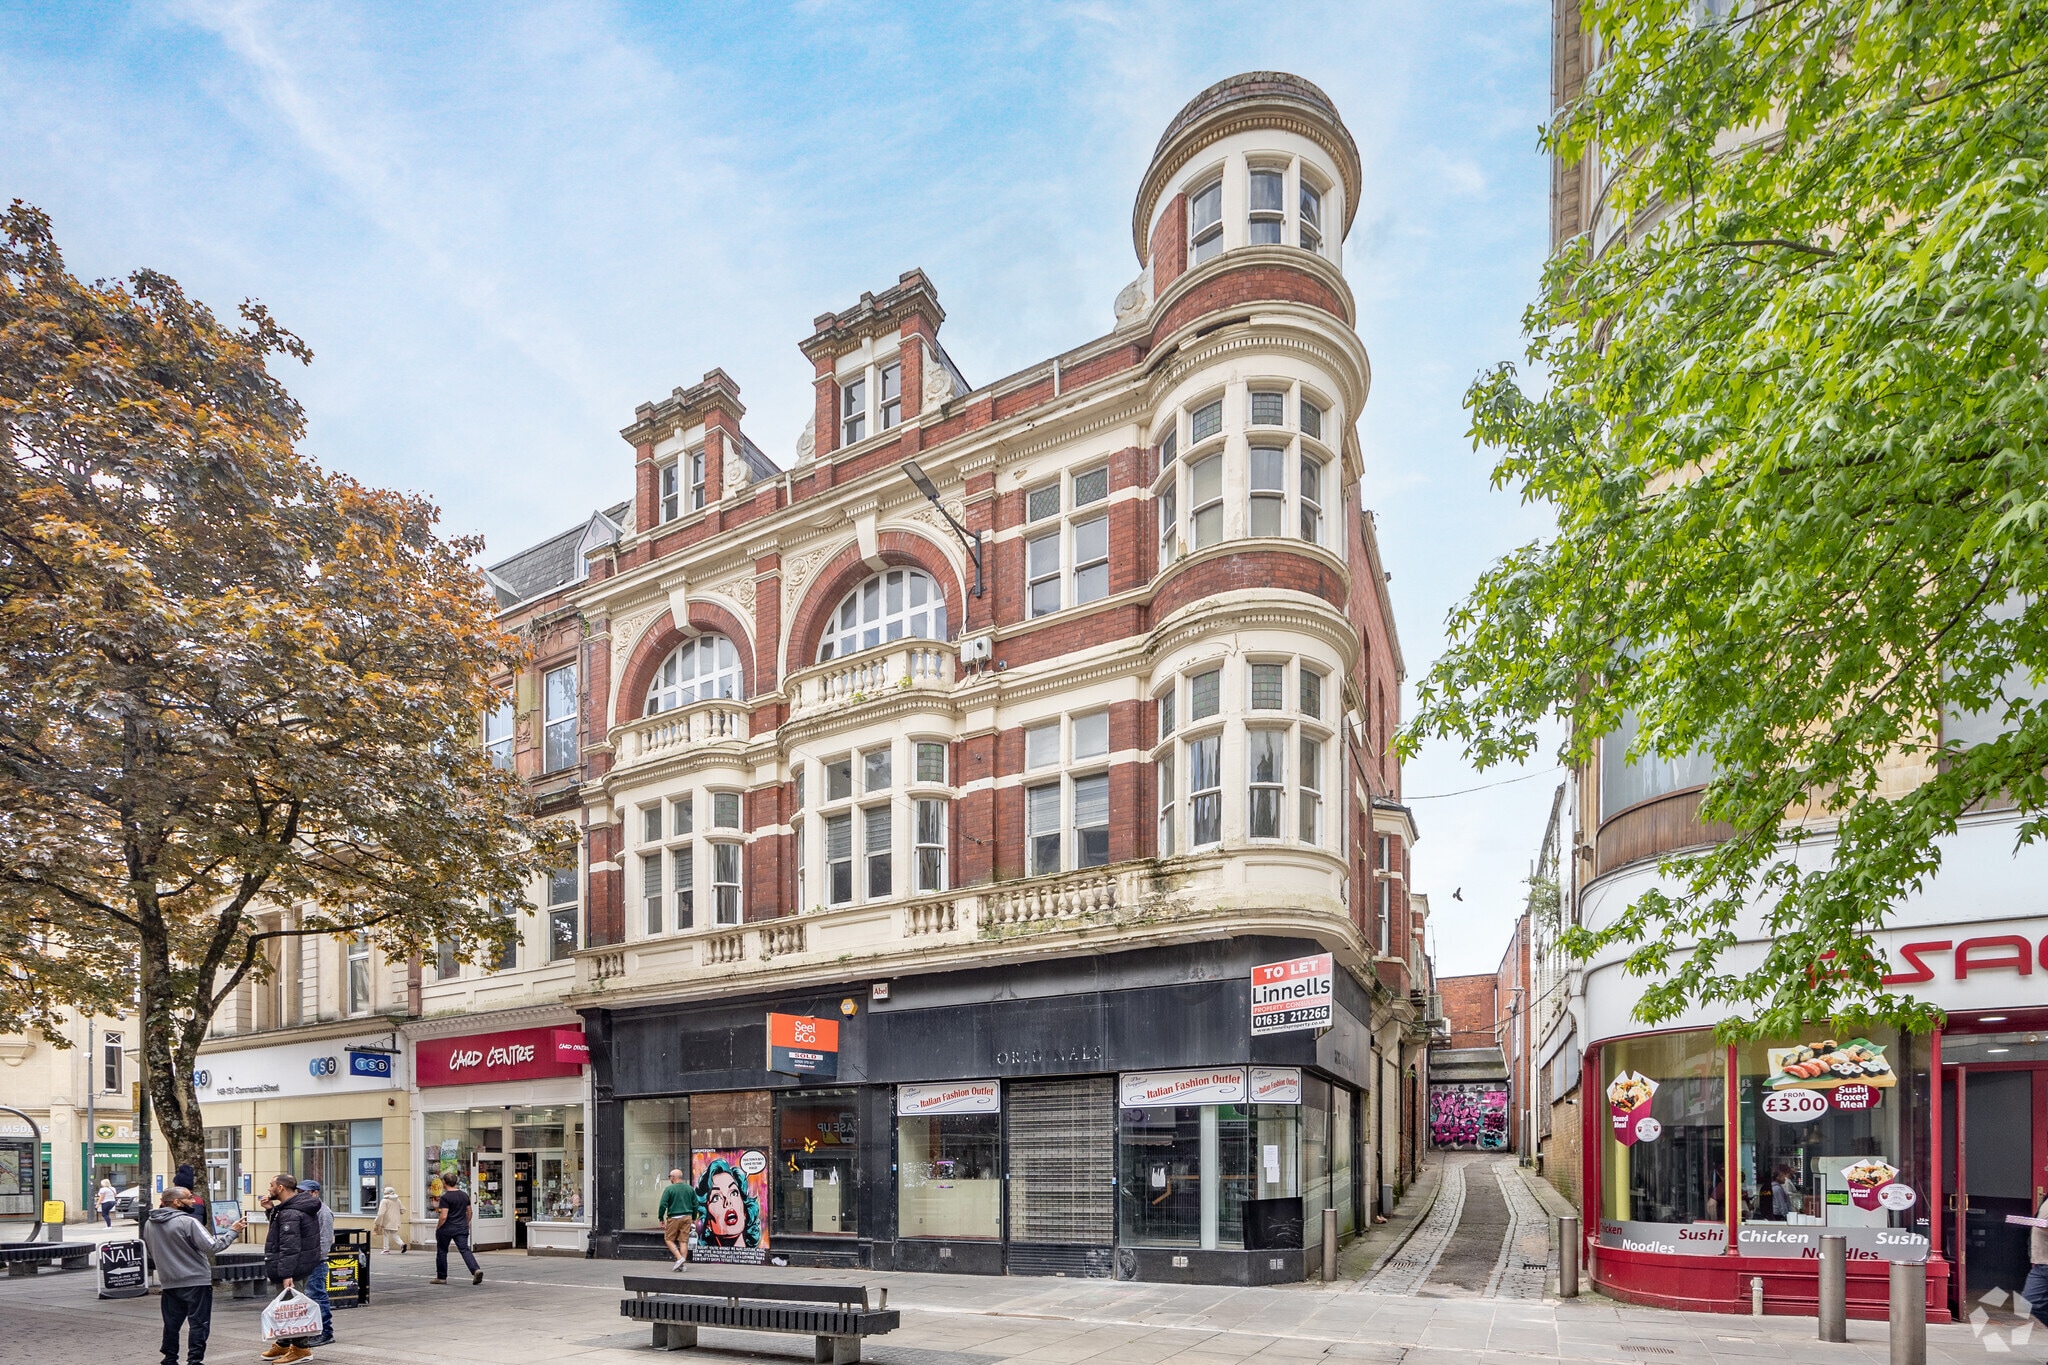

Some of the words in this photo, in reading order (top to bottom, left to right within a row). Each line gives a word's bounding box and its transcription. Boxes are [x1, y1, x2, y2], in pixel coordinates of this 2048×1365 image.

[1263, 966, 1284, 980] TO
[1290, 960, 1319, 975] LET
[873, 987, 888, 996] Abel
[1253, 977, 1331, 1005] Linnells
[1254, 1004, 1284, 1013] PROPERTY
[1285, 996, 1330, 1009] CONSULTANTS
[1255, 1013, 1285, 1027] 01633
[1290, 1007, 1328, 1022] 212266
[794, 1020, 816, 1033] Seel
[1257, 1020, 1326, 1033] www.linnellsproperty.co.uk
[794, 1032, 816, 1043] &Co
[449, 1049, 483, 1071] CARD
[486, 1044, 535, 1068] CENTRE
[996, 1045, 1102, 1065] ORIGNALS
[310, 1058, 336, 1075] TSB
[357, 1059, 386, 1071] TSB
[235, 1085, 263, 1094] Commercial
[263, 1083, 280, 1092] Street
[1146, 1086, 1173, 1099] Italian
[1174, 1076, 1210, 1092] Fashion
[1212, 1074, 1241, 1085] Outlet
[1258, 1084, 1271, 1094] Italian
[1271, 1078, 1286, 1090] Fashion
[1286, 1077, 1298, 1087] Outlet
[1838, 1085, 1868, 1094] Sushi
[920, 1096, 942, 1109] Italian
[942, 1089, 970, 1103] Fashion
[971, 1086, 994, 1096] Outlet
[1835, 1092, 1869, 1101] Boxed
[1765, 1097, 1825, 1112] £3.00
[1840, 1100, 1867, 1109] Meal
[1612, 1114, 1629, 1122] Boxed
[1614, 1121, 1627, 1129] Meal
[1678, 1229, 1724, 1241] Sushi
[1738, 1230, 1809, 1244] Chicken
[1622, 1239, 1675, 1254] Noodles
[102, 1248, 142, 1264] NAIL
[274, 1309, 308, 1320] DELIVERY
[269, 1321, 318, 1338] Iceland
